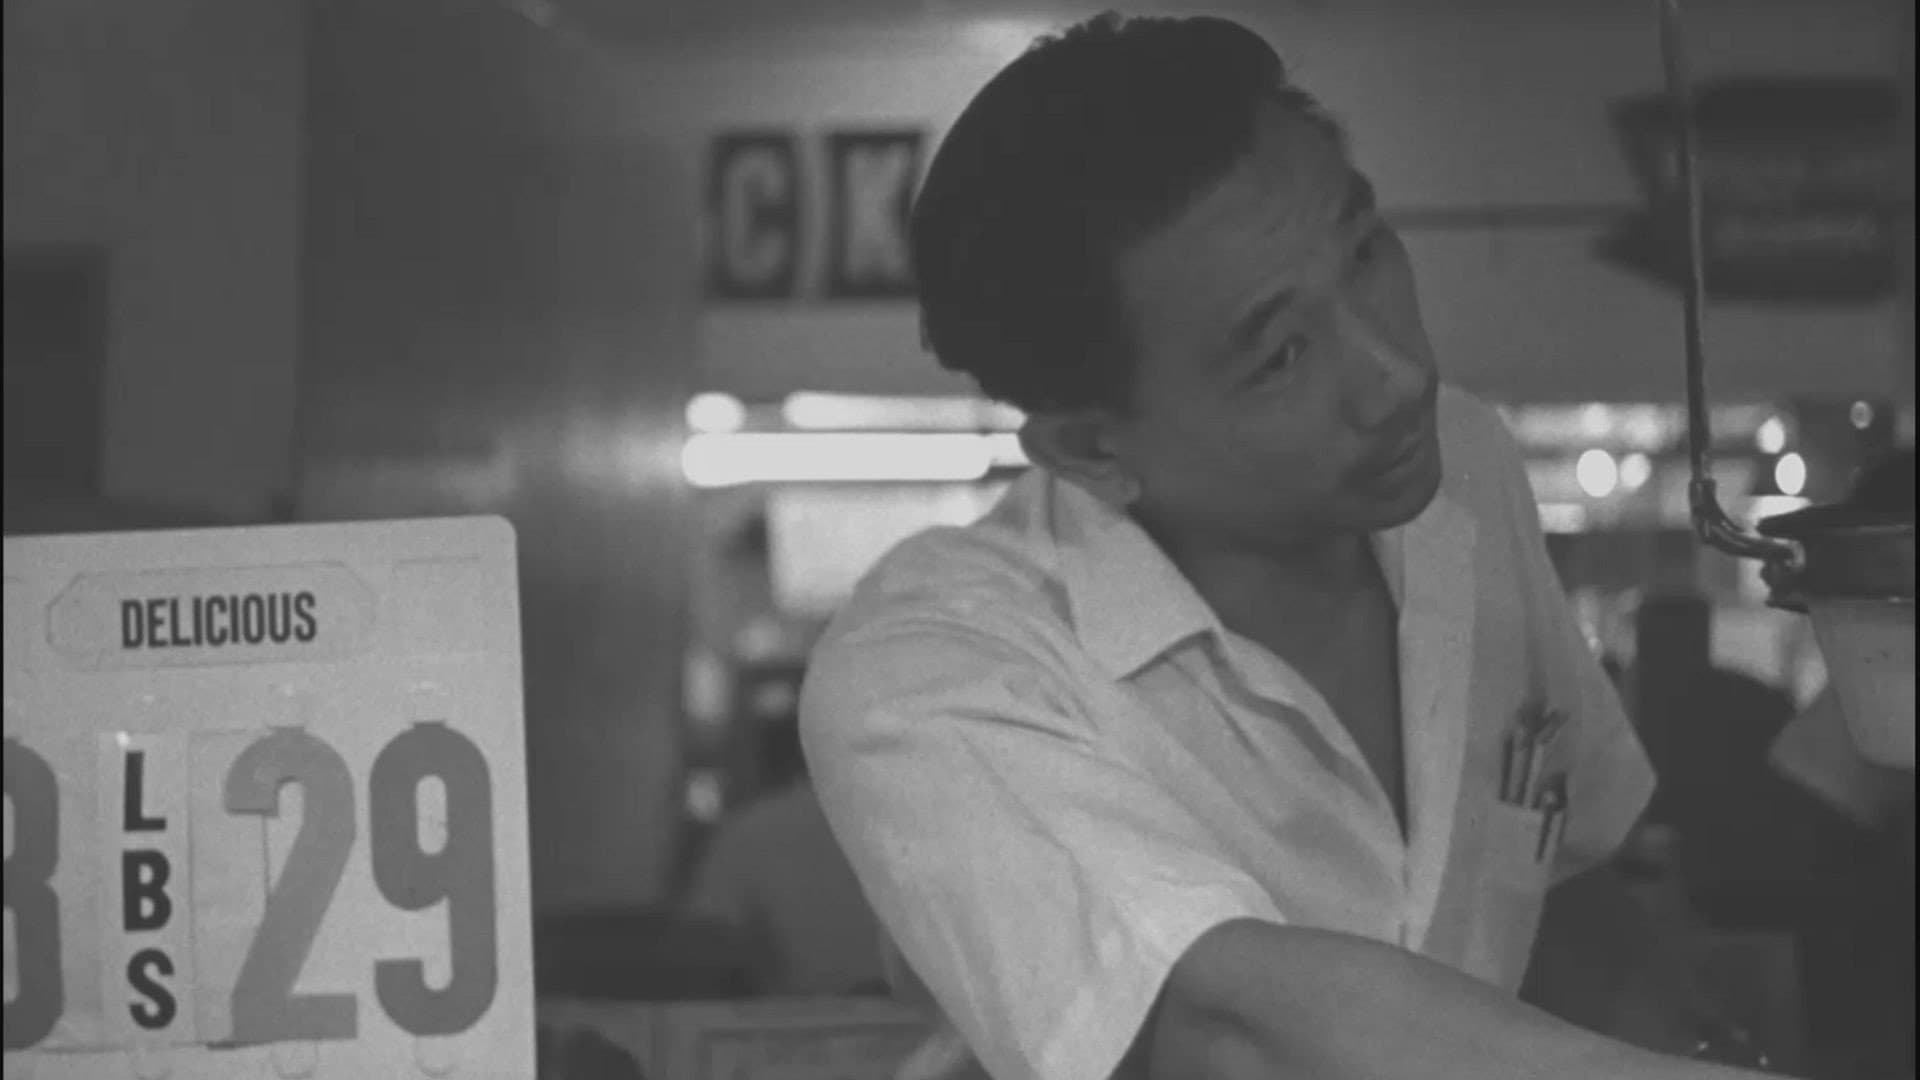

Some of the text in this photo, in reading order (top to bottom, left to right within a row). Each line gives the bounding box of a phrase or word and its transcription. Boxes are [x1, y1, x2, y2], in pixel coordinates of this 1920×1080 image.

[121, 591, 317, 649] DELICIOUS
[121, 749, 177, 1030] LBS
[223, 720, 498, 1042] 29
